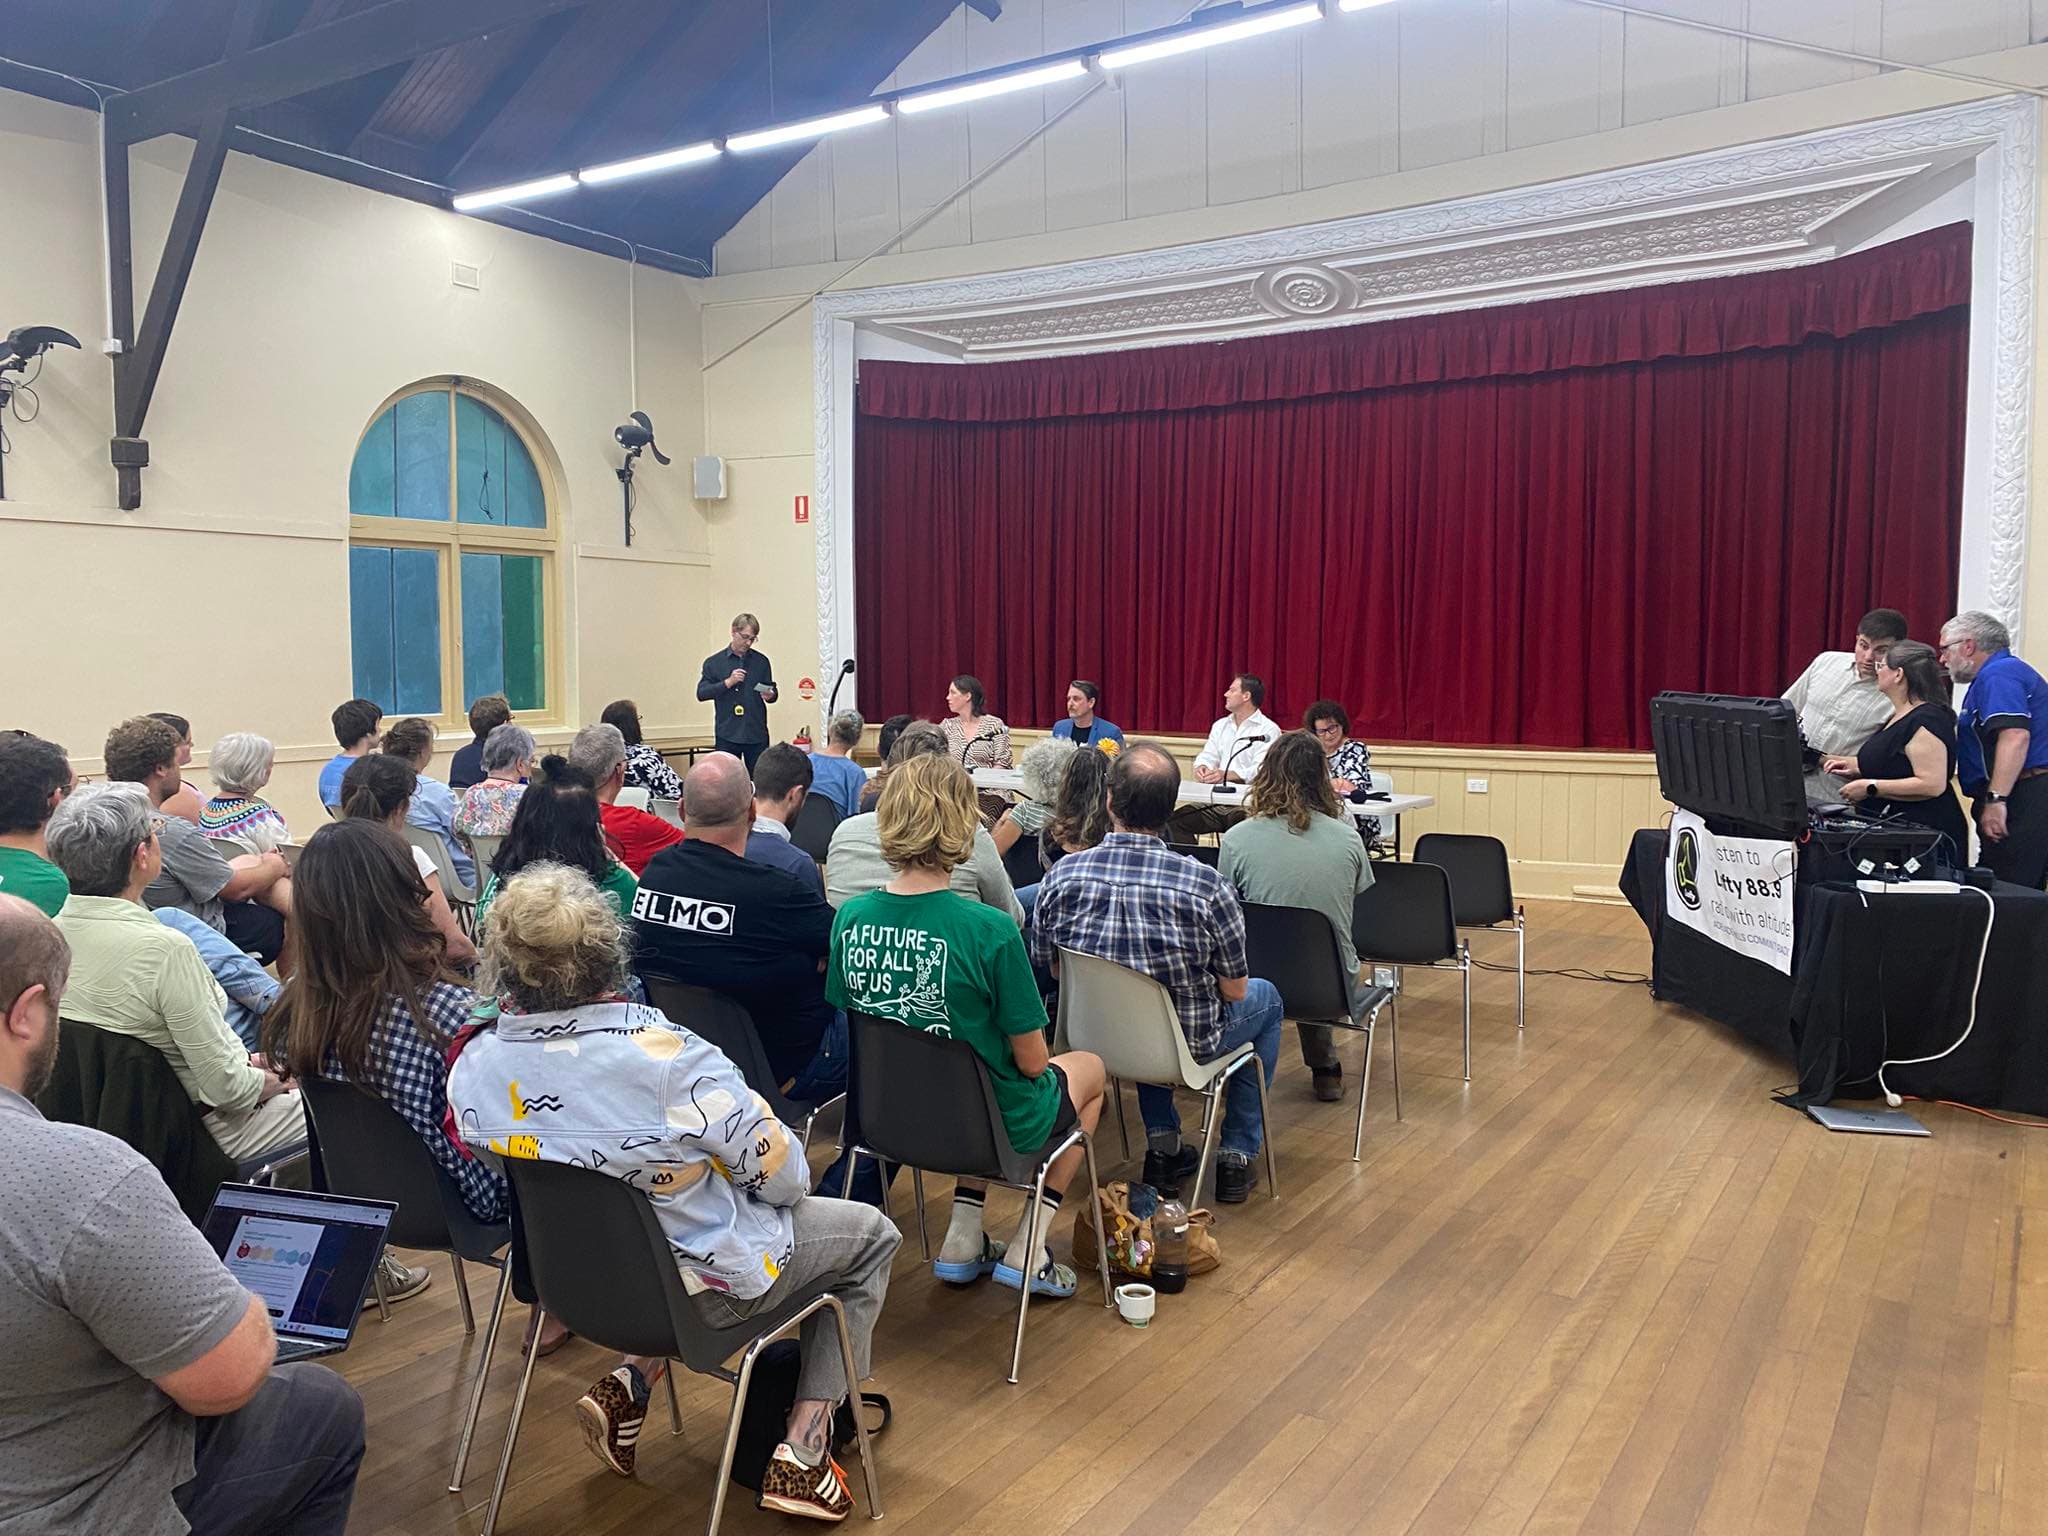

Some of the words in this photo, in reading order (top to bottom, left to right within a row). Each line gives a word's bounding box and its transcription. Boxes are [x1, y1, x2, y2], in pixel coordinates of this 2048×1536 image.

[1716, 846, 1743, 865] sten
[1746, 849, 1760, 866] to
[1714, 869, 1742, 899] Lfty
[1745, 878, 1782, 899] 88.9
[633, 890, 731, 931] ELMO
[849, 923, 858, 945] A
[861, 924, 928, 951] FUTURE
[1758, 911, 1791, 938] altitude
[848, 947, 877, 969] FOR
[881, 949, 914, 972] ALL
[848, 970, 867, 992] OF
[870, 972, 892, 995] US
